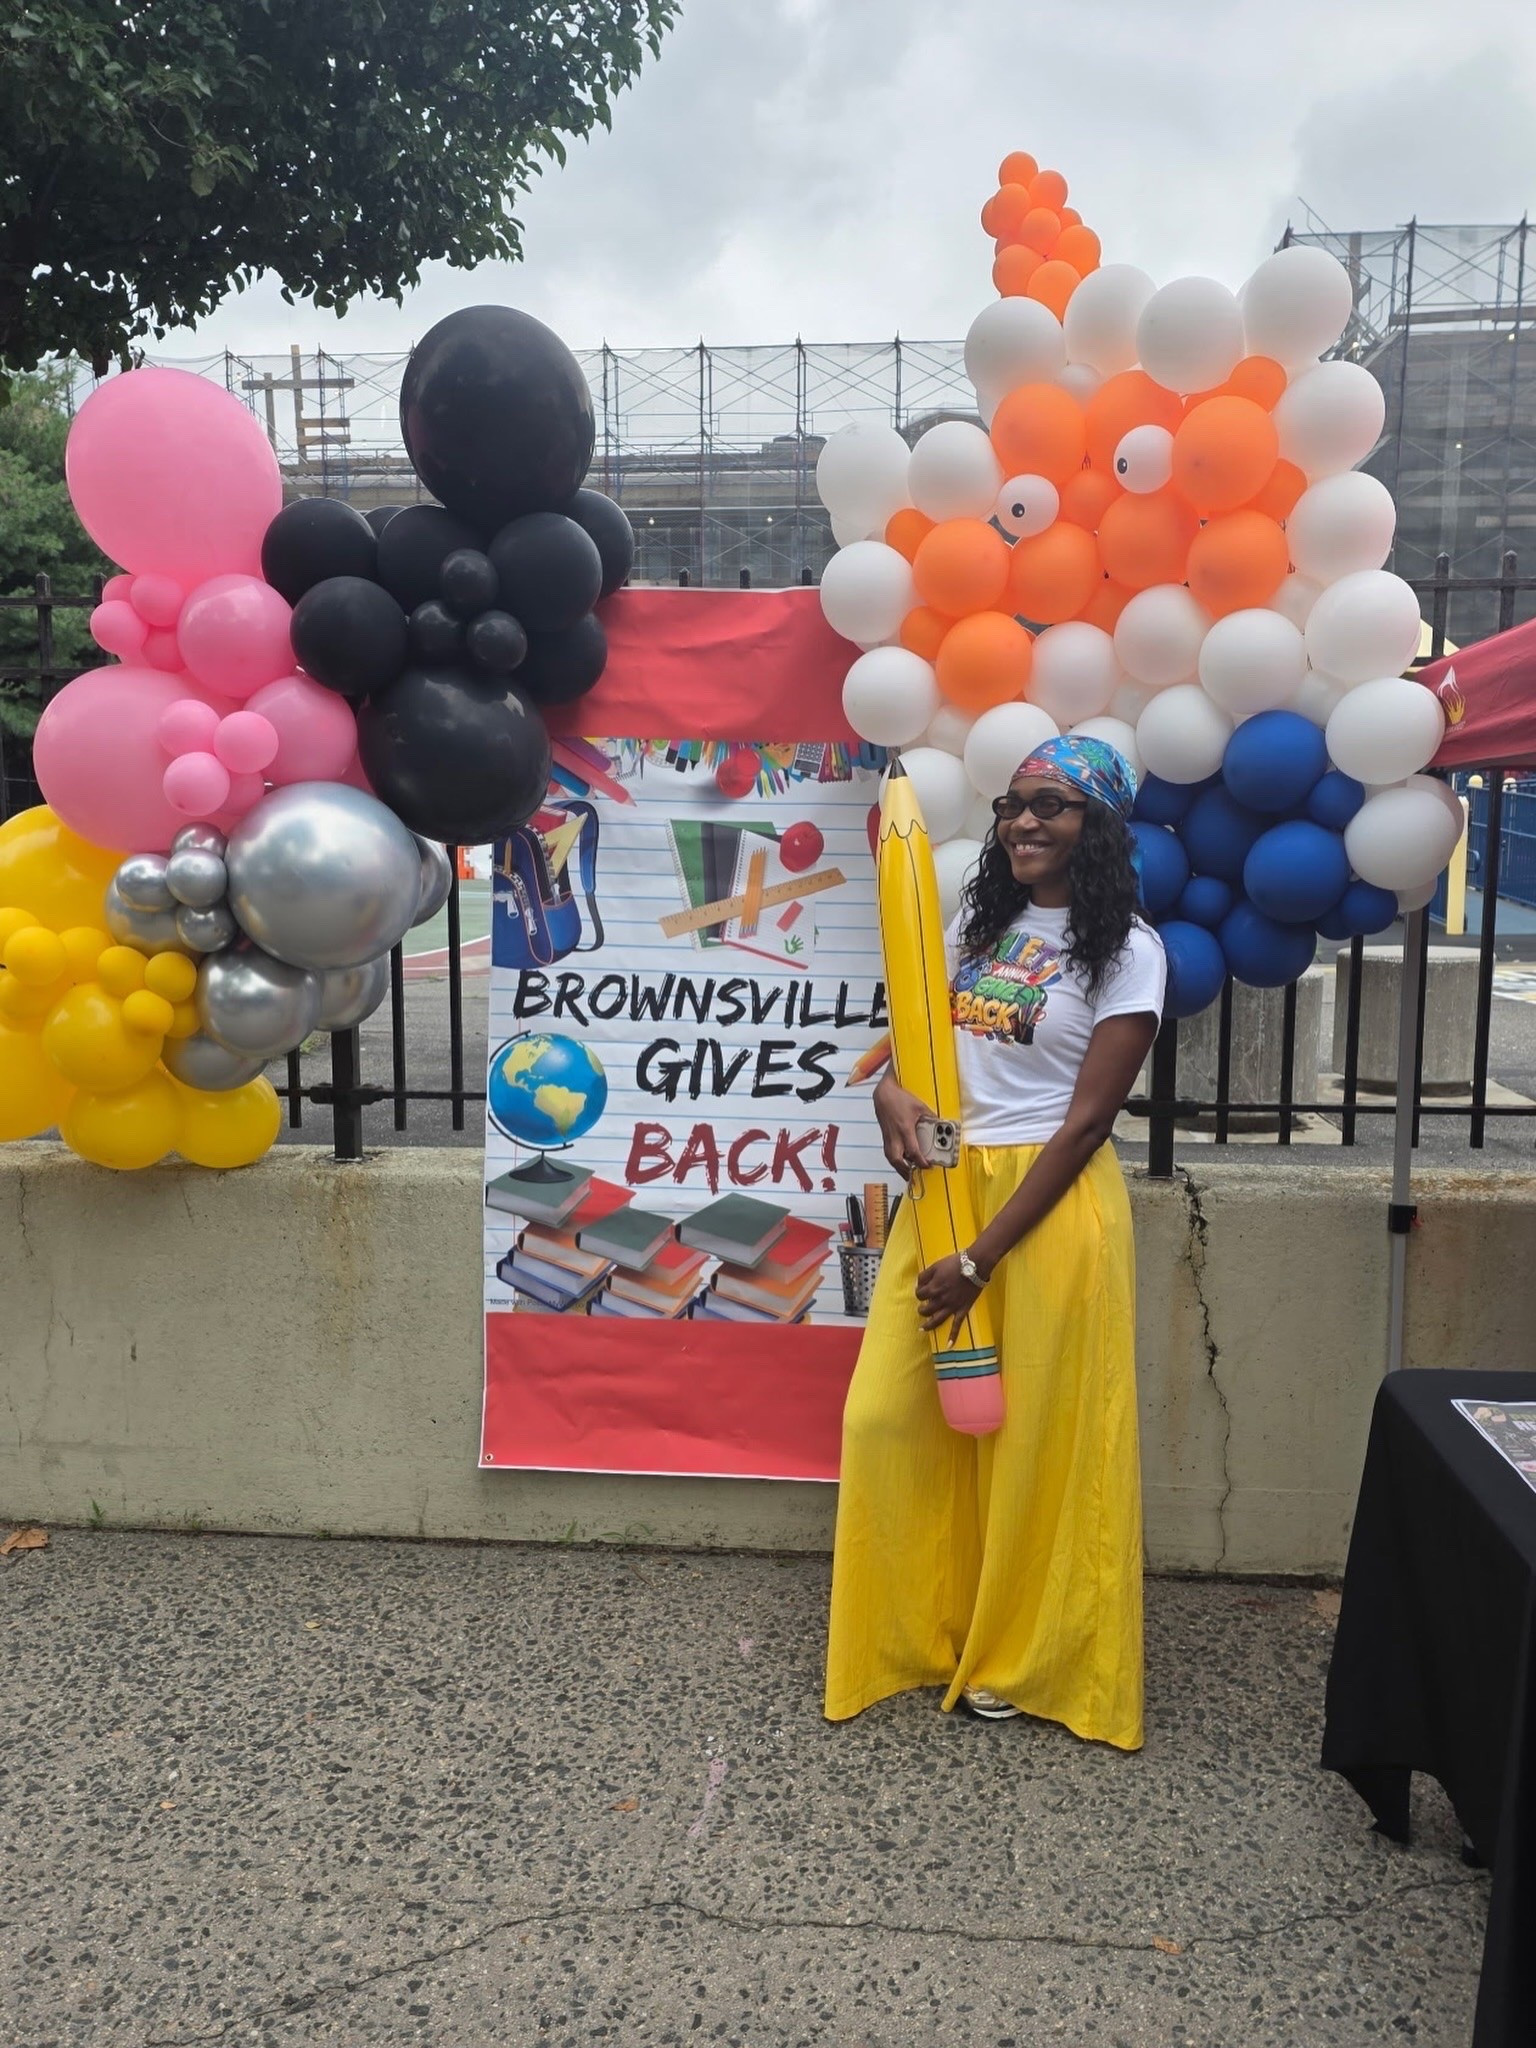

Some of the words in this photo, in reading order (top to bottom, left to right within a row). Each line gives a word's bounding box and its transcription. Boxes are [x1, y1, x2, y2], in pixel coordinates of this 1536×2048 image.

[956, 991, 1020, 1034] BACK
[973, 976, 1020, 1003] GIVE
[636, 1037, 839, 1104] GIVES
[624, 1121, 840, 1196] BACK!
